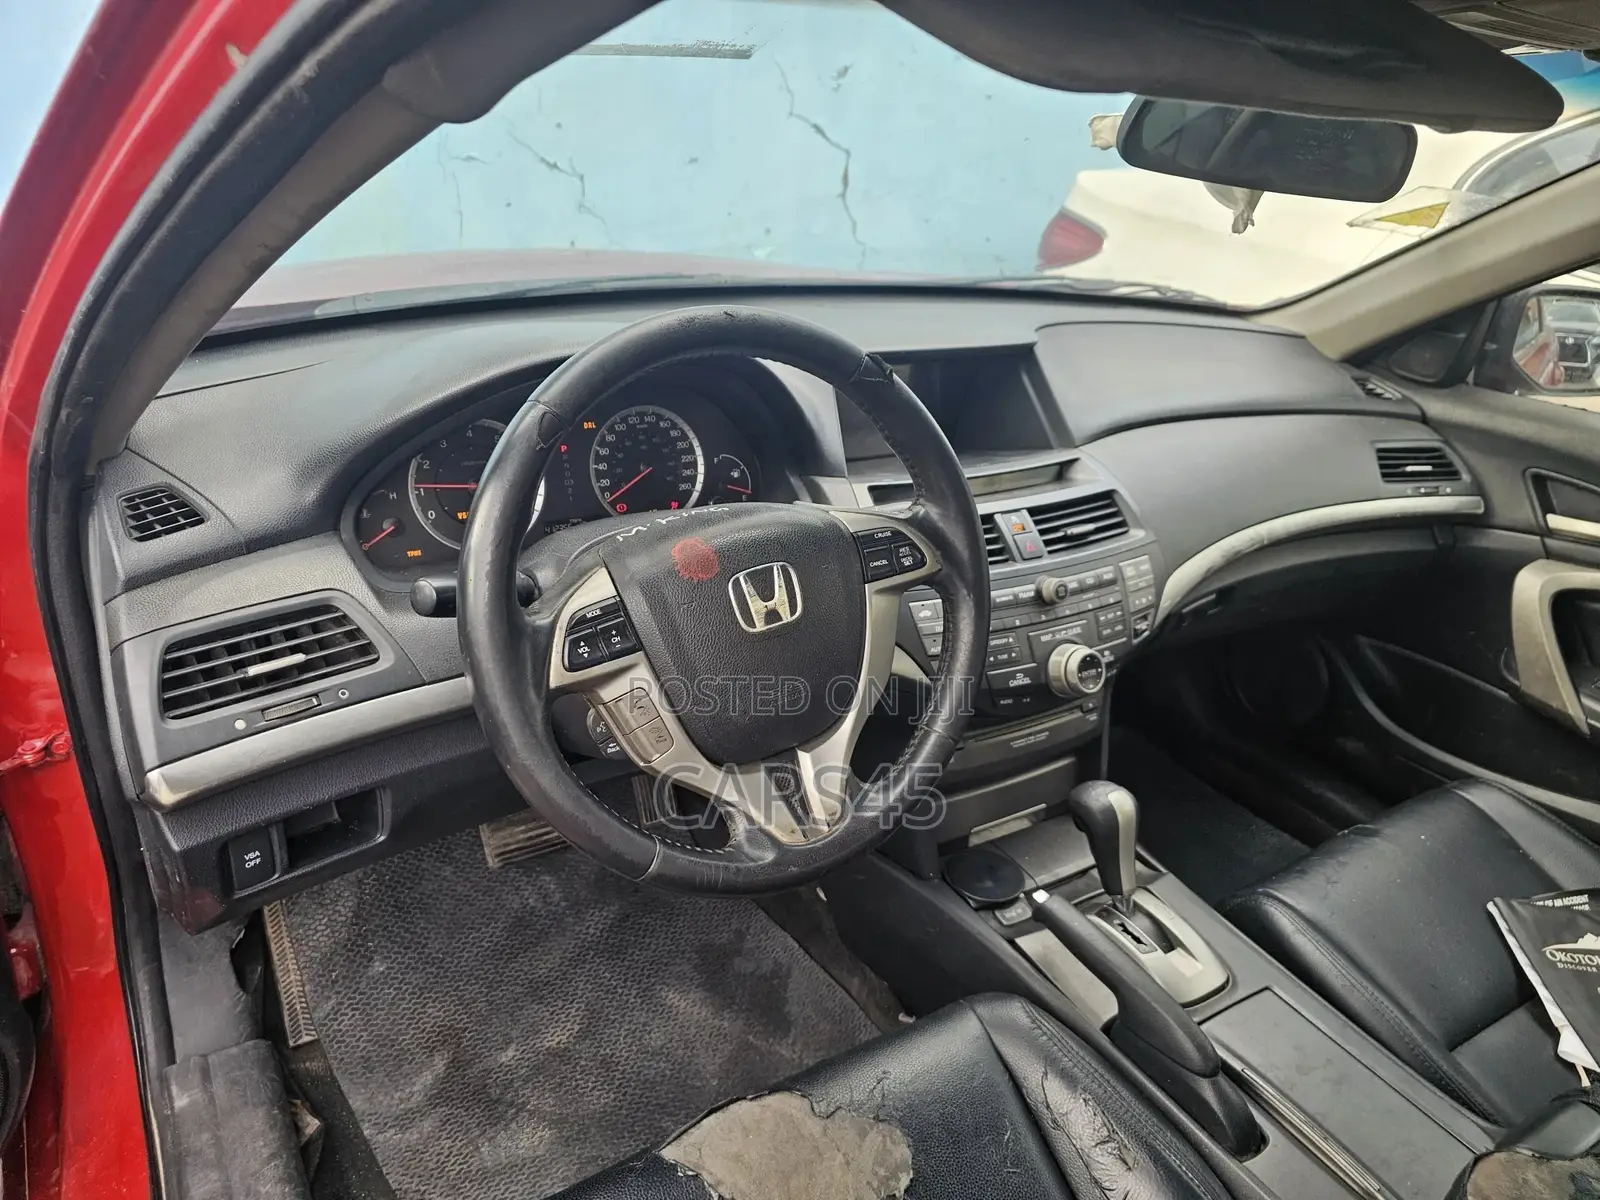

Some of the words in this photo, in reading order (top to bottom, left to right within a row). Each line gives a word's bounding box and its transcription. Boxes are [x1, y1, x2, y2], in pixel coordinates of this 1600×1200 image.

[628, 416, 640, 424] 120
[644, 415, 656, 423] 140
[583, 421, 597, 429] DRL
[614, 423, 627, 431] 100
[466, 429, 473, 437] 4
[669, 429, 681, 437] 180
[440, 440, 447, 448] 3
[560, 444, 568, 452] P
[423, 460, 430, 469] 2
[597, 462, 607, 470] 40
[679, 483, 691, 491] 260
[419, 488, 425, 496] 1
[427, 510, 436, 519] 0
[873, 530, 893, 539] CRUISE
[869, 559, 889, 568] CANCEL
[585, 609, 602, 618] MODE
[611, 635, 621, 643] CH
[577, 646, 591, 654] VOL
[1008, 676, 1032, 687] CANCEL
[244, 850, 261, 861] VSA
[245, 857, 262, 869] OFF
[1545, 949, 1600, 966] OKOTO
[1556, 961, 1598, 973] DISCOVER
